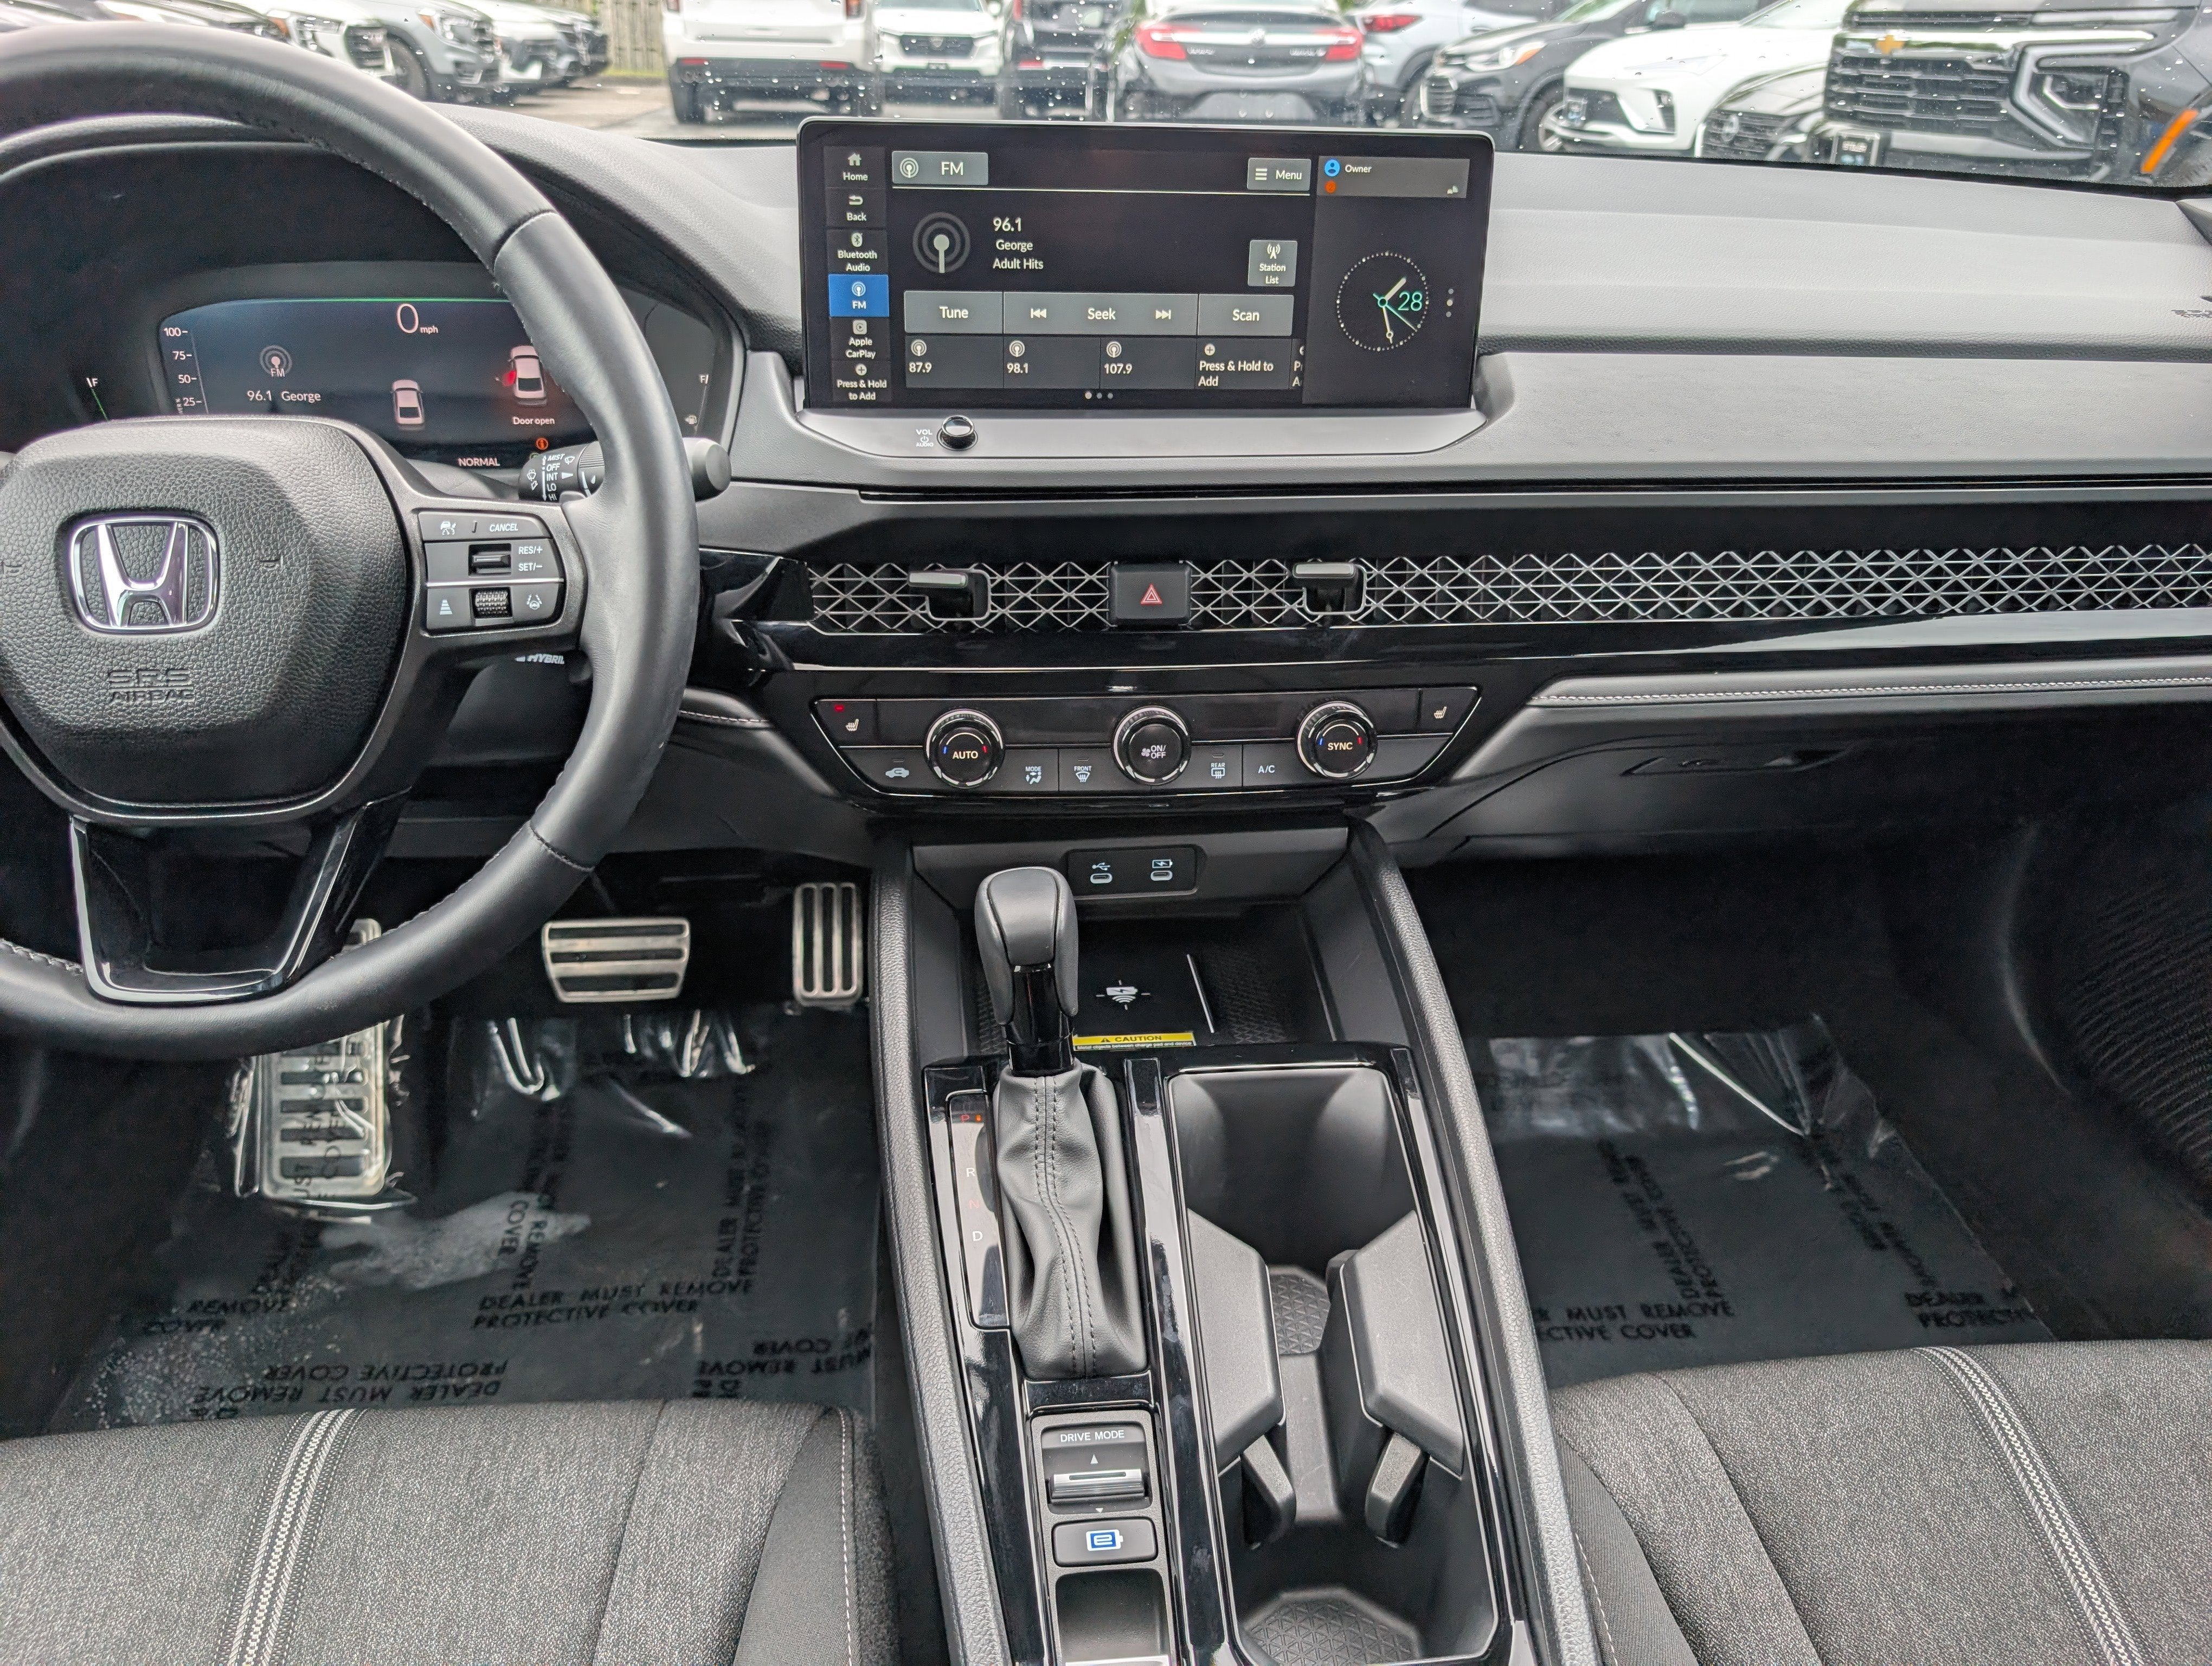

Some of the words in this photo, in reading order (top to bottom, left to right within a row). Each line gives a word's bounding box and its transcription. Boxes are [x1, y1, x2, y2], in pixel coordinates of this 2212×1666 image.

[941, 161, 964, 176] FM
[1345, 164, 1372, 174] Owner
[843, 171, 868, 181] Home
[1275, 169, 1302, 181] Menu
[846, 212, 867, 221] Back
[993, 217, 1023, 232] 96.1
[996, 240, 1033, 253] George
[838, 249, 878, 259] Bluetooth
[846, 262, 871, 272] Audio
[993, 258, 1020, 270] Adult
[1023, 258, 1044, 271] Hits
[1259, 263, 1286, 272] Station
[1265, 275, 1279, 285] List
[852, 300, 866, 309] FM
[1398, 291, 1424, 312] 28
[940, 306, 969, 319] Tune
[1087, 307, 1116, 320] Seek
[1232, 309, 1260, 322] Scan
[396, 303, 419, 334] 0
[420, 324, 438, 335] mph
[164, 327, 182, 337] 100
[848, 337, 872, 347] Apple
[172, 351, 186, 360] 75
[845, 349, 876, 360] CarPlay
[909, 362, 932, 374] 87.9
[1006, 363, 1029, 374] 98.1
[1104, 363, 1133, 375] 107.9
[1199, 361, 1225, 372] Press
[1227, 361, 1236, 372] &
[1238, 361, 1261, 372] Hold
[1263, 362, 1274, 372] to
[271, 368, 285, 377] FM
[178, 374, 191, 383] 50
[837, 380, 858, 388] Press
[859, 380, 866, 388] &
[868, 380, 888, 388] Hold
[1198, 376, 1219, 387] Add
[247, 390, 272, 402] 96.1
[281, 390, 321, 402] George
[848, 392, 858, 400] to
[859, 392, 876, 400] Add
[183, 397, 196, 407] 25
[512, 416, 533, 425] Door
[535, 418, 555, 426] open
[458, 457, 501, 467] NORMAL
[547, 453, 565, 462] MIST
[546, 463, 561, 472] OFF
[546, 472, 558, 482] INT
[546, 483, 557, 492] LO
[489, 523, 519, 533] CANCEL
[518, 546, 543, 555] RES/+
[108, 668, 192, 688] SRS
[110, 690, 196, 703] AIRBAG
[1327, 742, 1353, 752] SYNC
[953, 749, 978, 760] AUTO
[1258, 765, 1275, 774] A/C
[961, 1114, 969, 1123] P
[967, 1167, 975, 1177] R
[969, 1199, 980, 1209] N
[499, 1200, 529, 1255] COVER
[972, 1231, 983, 1241] D
[479, 1290, 564, 1311] DEALER
[580, 1283, 646, 1302] MUST
[659, 1278, 754, 1296] REMOVE
[471, 1303, 610, 1330] PROTECTIVE
[621, 1299, 699, 1315] COVER
[1566, 1304, 1626, 1322] MUST
[1639, 1300, 1736, 1318] REMOVE
[1621, 1323, 1698, 1340] COVER
[752, 1338, 831, 1355] COVER
[265, 1364, 350, 1382] COVER
[361, 1360, 509, 1383] PROTECTIVE
[193, 1385, 304, 1404] REMOVE
[318, 1384, 392, 1401] MUST
[410, 1381, 502, 1400] DEALER
[1060, 1431, 1091, 1443] DRIVE
[1094, 1430, 1125, 1440] MODE
